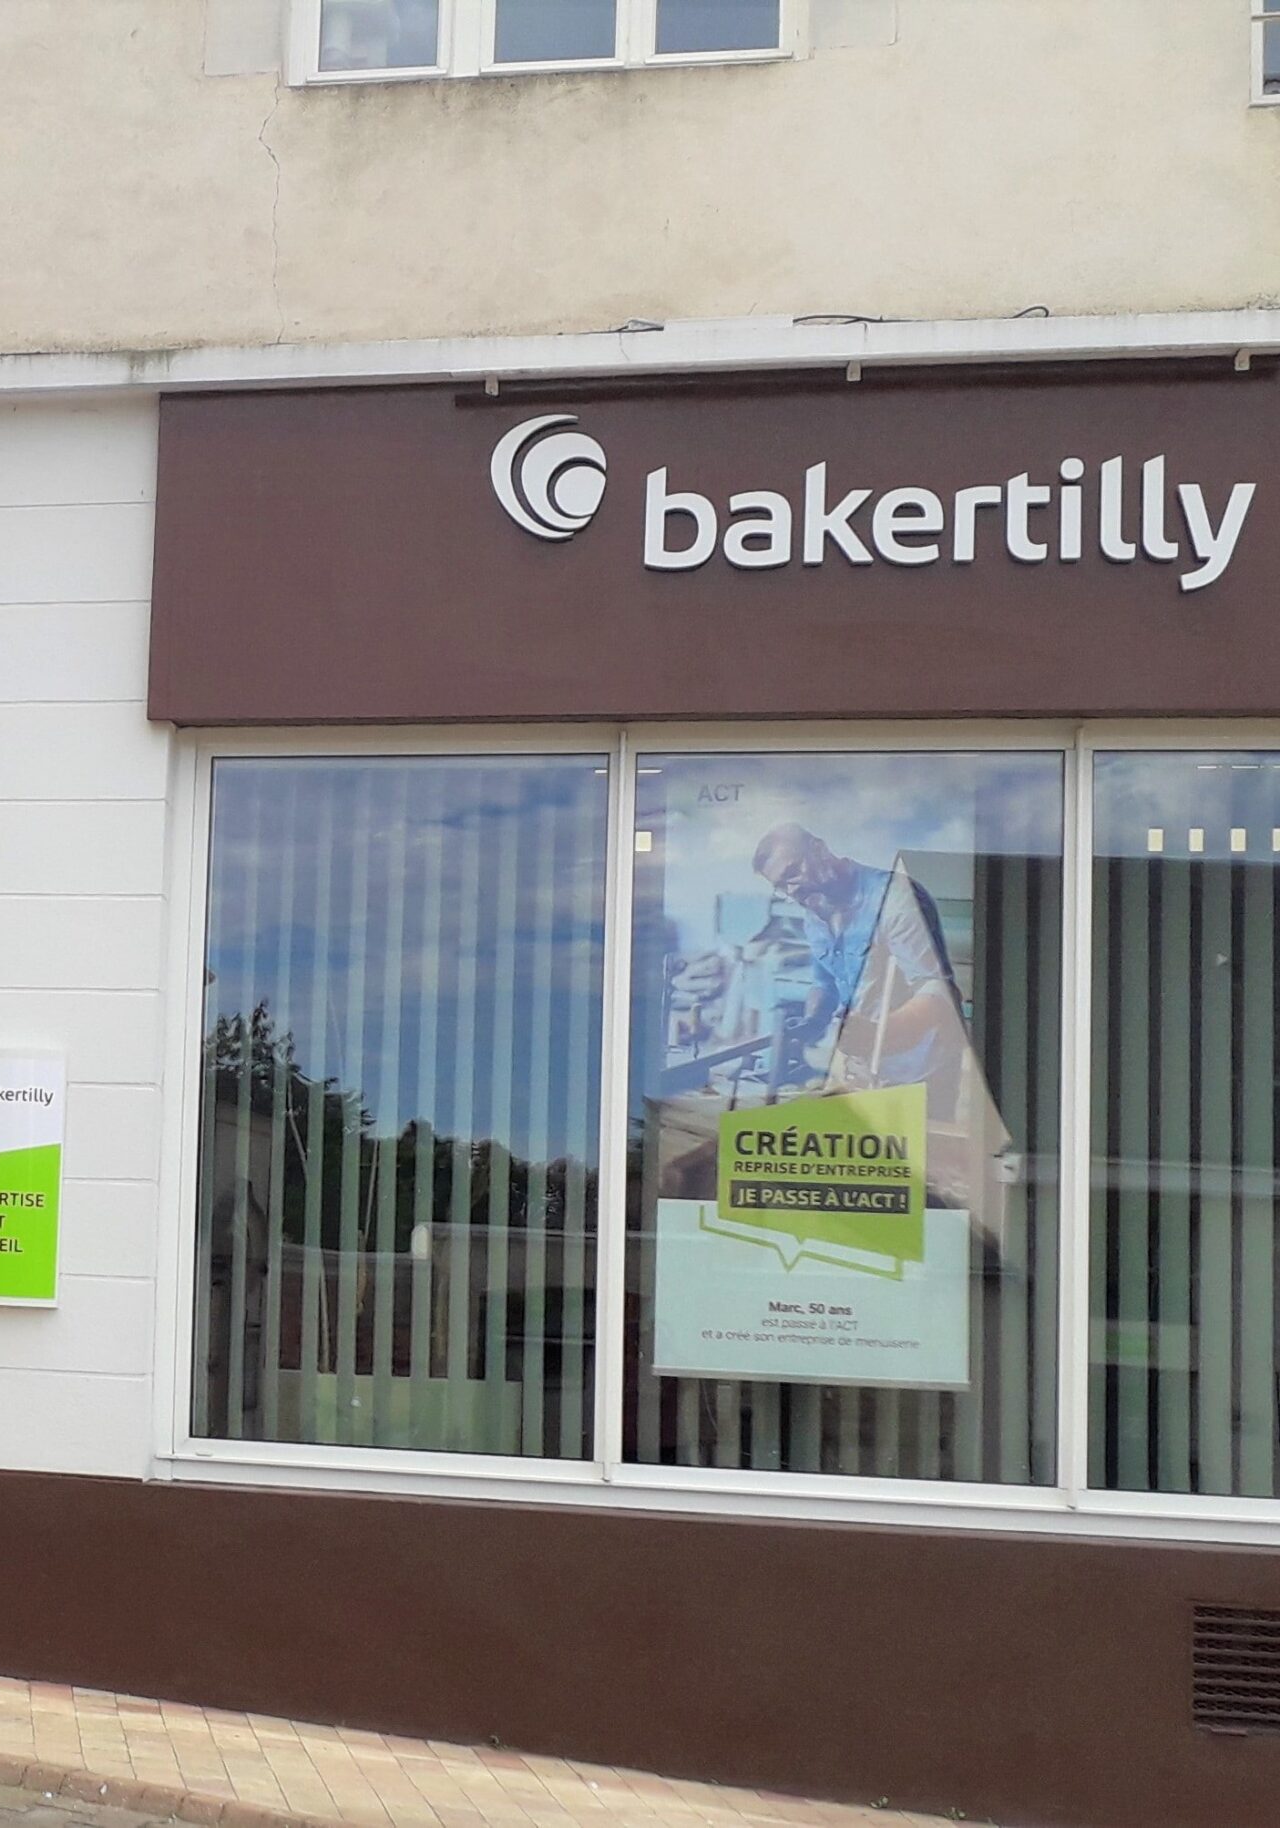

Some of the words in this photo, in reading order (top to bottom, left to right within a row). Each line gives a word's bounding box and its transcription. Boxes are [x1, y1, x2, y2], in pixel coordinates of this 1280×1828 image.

[643, 454, 1257, 592] bakertilly
[698, 783, 744, 802] ACT
[735, 1125, 908, 1160] CRÉATION
[734, 1161, 797, 1175] REPRISE
[801, 1163, 911, 1178] D'ENTREPRISE
[737, 1188, 757, 1205] JE
[761, 1188, 821, 1206] PASSE
[824, 1187, 840, 1207] À
[844, 1190, 895, 1209] L'ACT
[768, 1301, 804, 1315] Marc,
[809, 1302, 825, 1315] 50
[828, 1306, 852, 1316] ans
[701, 1329, 713, 1340] et
